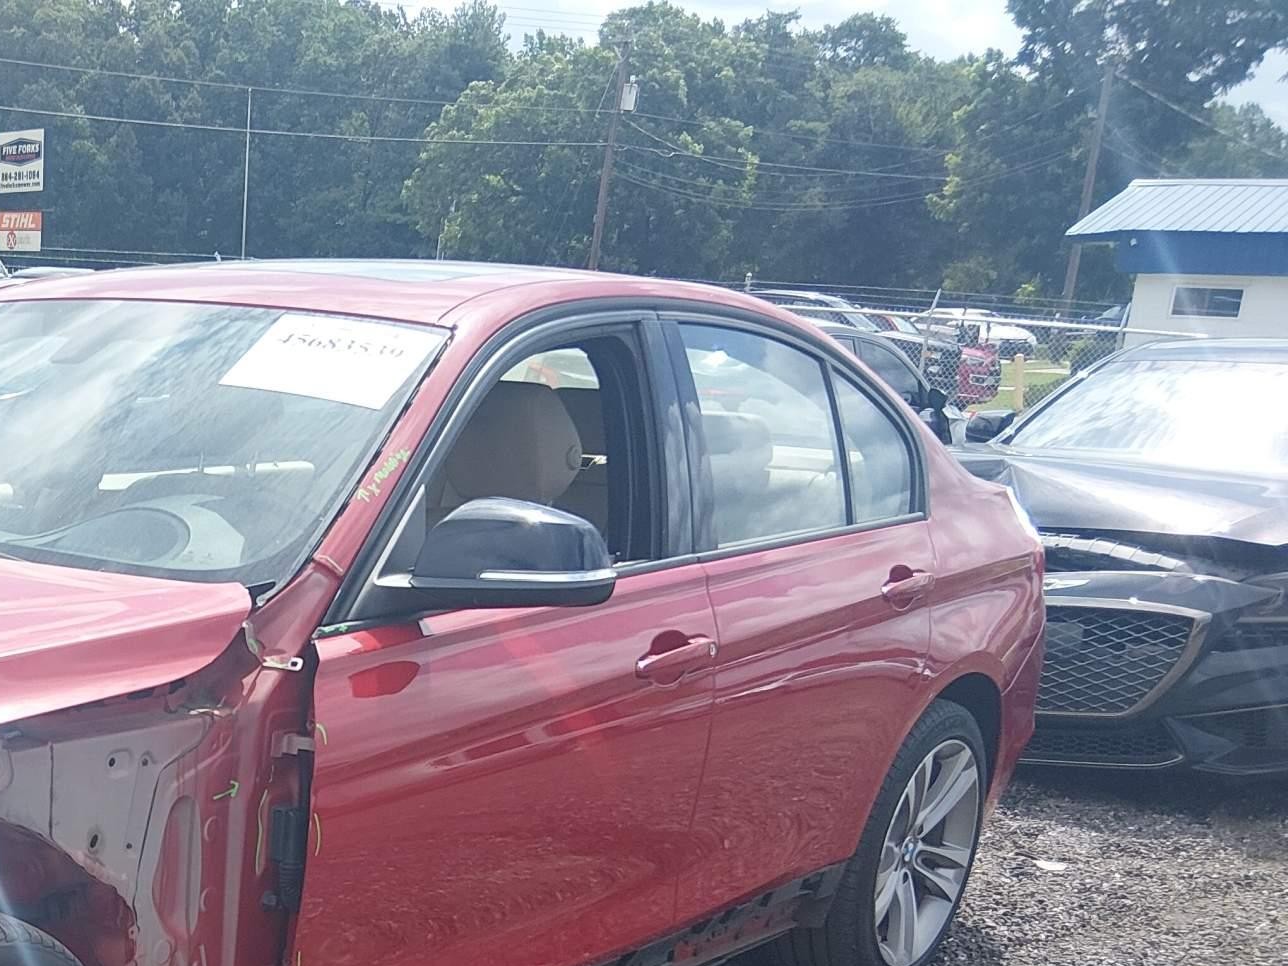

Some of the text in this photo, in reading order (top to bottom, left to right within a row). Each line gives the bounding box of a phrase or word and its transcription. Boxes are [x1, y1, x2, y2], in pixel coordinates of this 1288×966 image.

[2, 143, 40, 155] FIVE FORKS
[0, 213, 36, 229] STIHL
